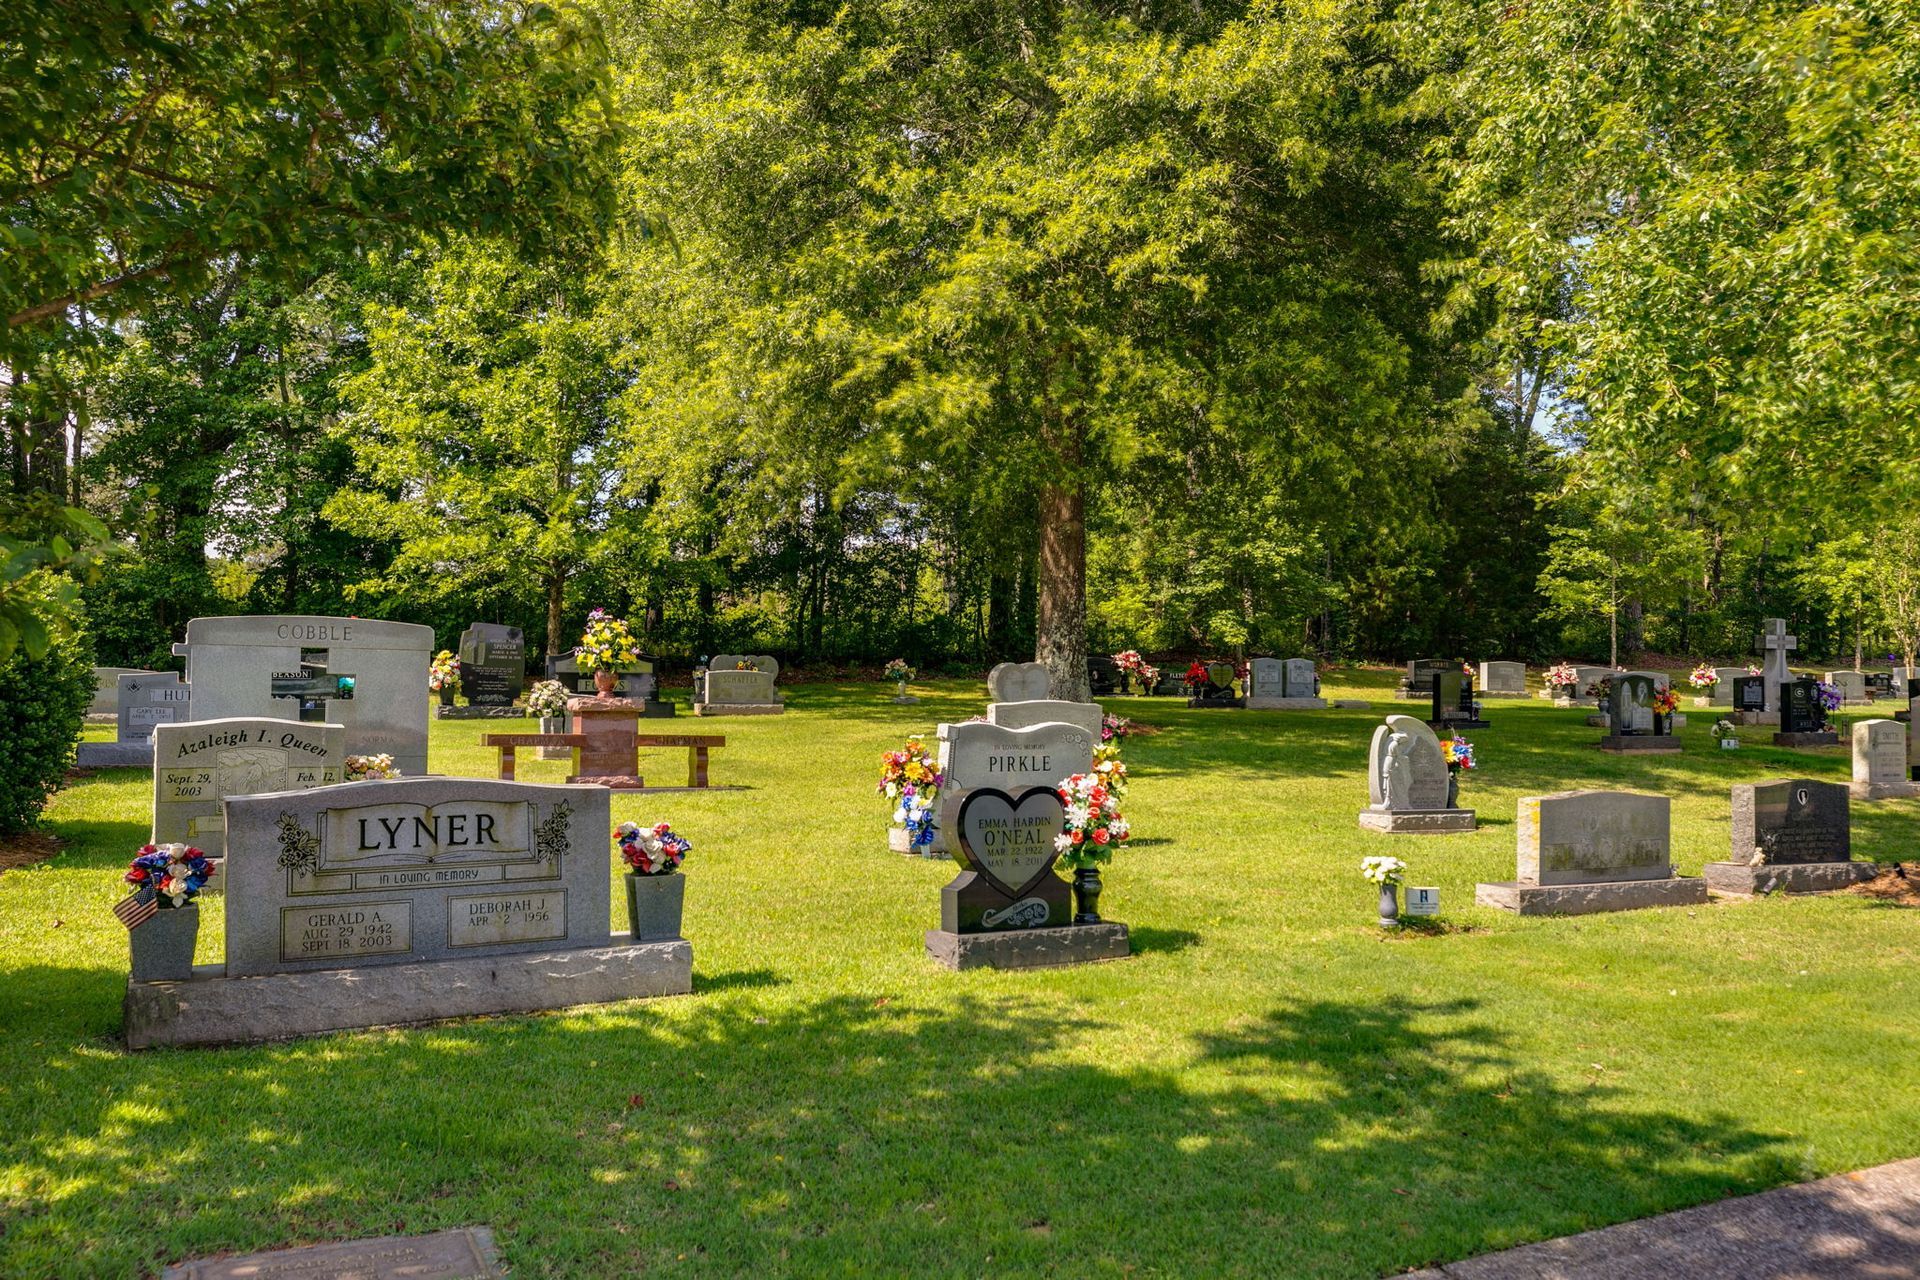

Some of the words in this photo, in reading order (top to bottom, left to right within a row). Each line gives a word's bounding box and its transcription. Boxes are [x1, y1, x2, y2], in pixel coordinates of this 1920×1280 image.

[277, 624, 353, 641] COBBLE
[272, 670, 309, 678] BEASON
[177, 729, 248, 759] Azaleigh
[257, 729, 272, 743] I.
[281, 732, 328, 757] Queen
[509, 735, 566, 746] CHAPMAN
[655, 735, 706, 746] CHAPMAN
[989, 755, 1052, 772] PIRKLE
[166, 773, 194, 786] Sept.
[197, 773, 212, 784] 29,
[297, 772, 316, 782] Feb.
[323, 772, 336, 782] 12,
[174, 787, 202, 797] 2003
[978, 818, 1008, 829] EMMA
[1013, 816, 1051, 828] HARDIN
[358, 813, 499, 851] LYNER
[984, 828, 1045, 846] O'NEAL
[1025, 846, 1043, 855] 1922
[987, 858, 1005, 867] MAY
[379, 874, 389, 884] IN
[394, 871, 431, 884] LOVING
[435, 869, 479, 881] MEMORY
[469, 899, 531, 915] DEBORAH
[308, 912, 365, 927] GERALD
[524, 911, 549, 923] 1956
[364, 923, 392, 935] 1942
[359, 935, 392, 948] 2003
